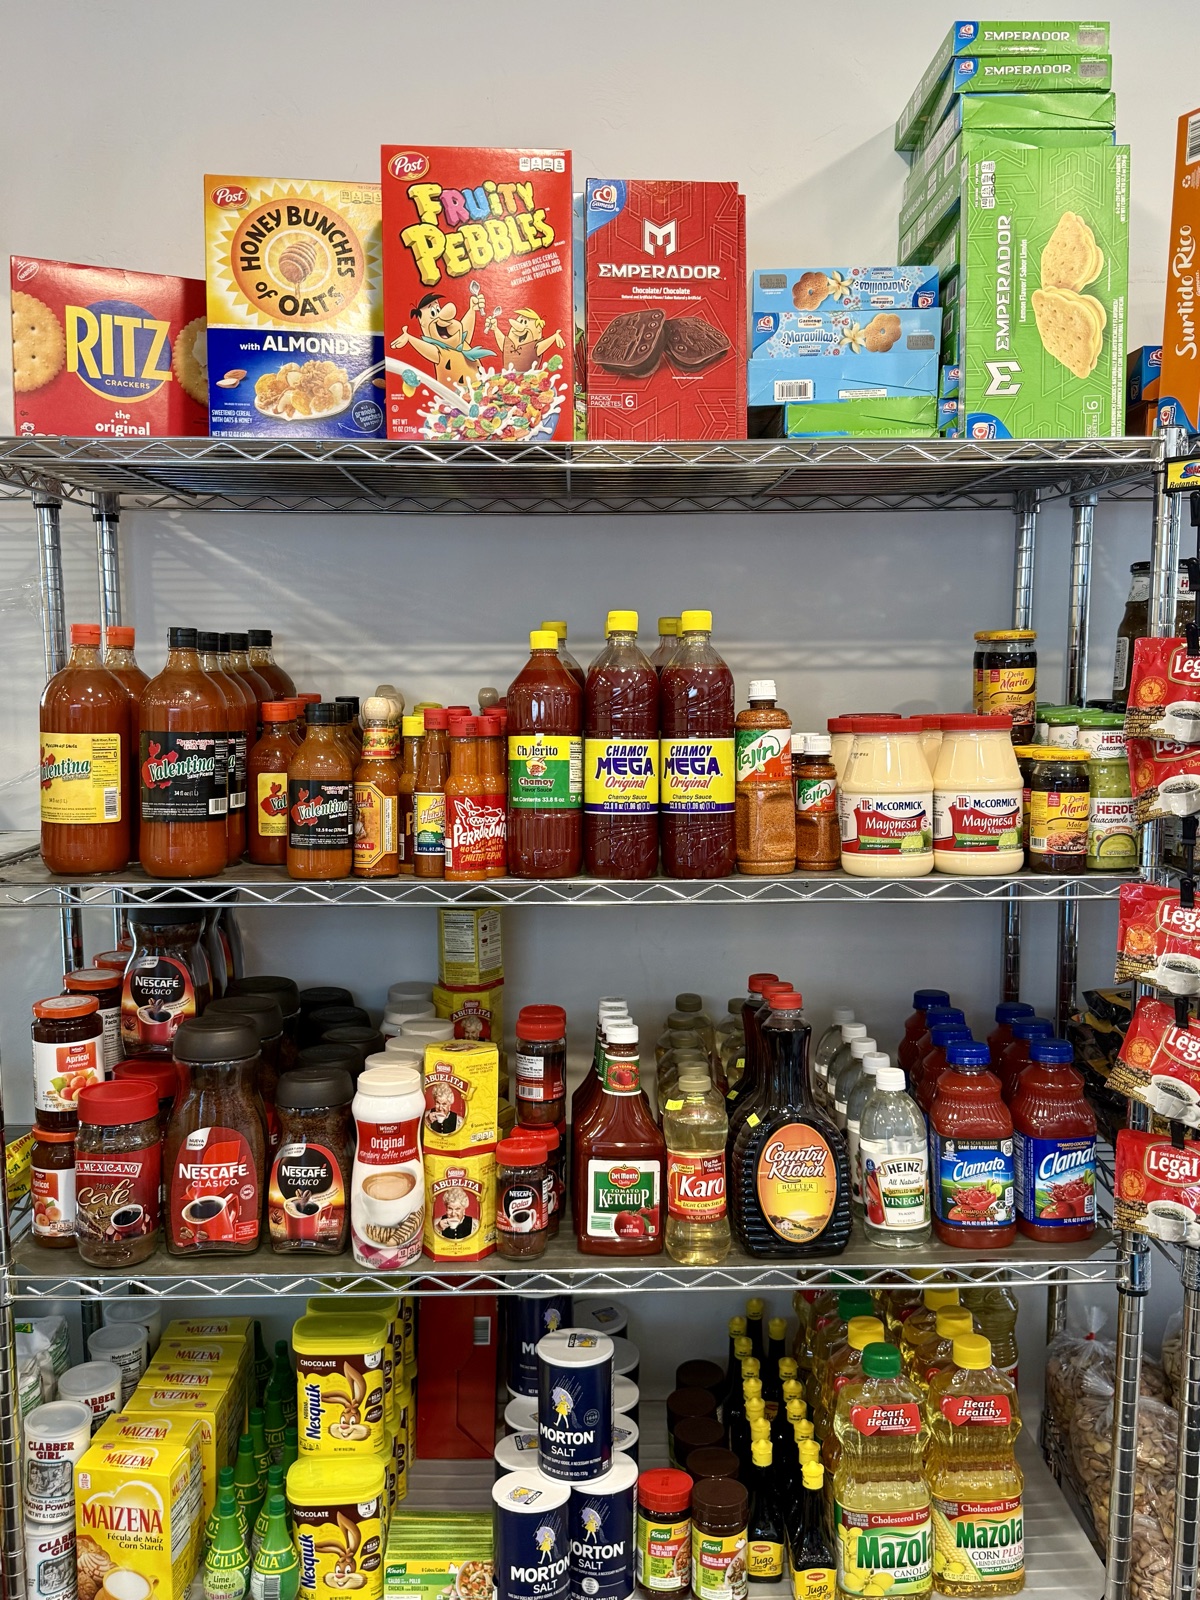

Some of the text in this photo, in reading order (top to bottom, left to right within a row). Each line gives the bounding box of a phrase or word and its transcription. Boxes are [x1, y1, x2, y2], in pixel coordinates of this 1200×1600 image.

[984, 31, 1070, 41] EMPERADOR
[984, 64, 1072, 76] EMPERADOR
[394, 157, 423, 176] Post
[215, 187, 245, 204] Post
[241, 205, 356, 279] HONEY BUNCHES
[400, 209, 555, 286] PEBBLES
[1019, 239, 1028, 258] Limón
[507, 252, 559, 274] SWEETENED RICE CEREAL
[532, 259, 561, 274] NATURAL AND
[510, 266, 562, 286] ARTIFICIAL FRUIT FLAVOR
[598, 263, 722, 280] EMPERADOR
[996, 215, 1011, 351] EMPERADOR
[255, 281, 278, 300] of
[663, 287, 690, 295] Chocolate
[1172, 224, 1197, 359] Surtido Rico
[1019, 303, 1027, 323] Lemon
[65, 305, 173, 382] RITZ
[784, 330, 834, 346] Maravillas
[240, 336, 361, 356] with ALMONDS
[105, 379, 151, 390] CRACKERS
[625, 395, 634, 407] 6
[1087, 400, 1099, 411] 6
[115, 410, 131, 421] the
[355, 408, 376, 419] granola
[95, 419, 150, 436] original
[1170, 480, 1198, 489] Botanas
[606, 745, 648, 757] CHAMOY
[670, 745, 712, 757] CHAMOY
[149, 754, 215, 782] Valentina
[595, 757, 655, 779] MEGA
[664, 757, 723, 779] MEGA
[519, 777, 555, 788] Chamoy
[605, 776, 648, 792] Original
[670, 776, 713, 792] Original
[875, 801, 923, 811] McCORMICK
[973, 798, 1017, 808] McCORMICK
[962, 814, 1013, 833] Mayonesa
[1090, 815, 1127, 824] Guacamole
[866, 817, 917, 835] Mayonesa
[135, 975, 181, 988] NESCAFÉ
[141, 987, 173, 996] CLÁSICO
[452, 1009, 491, 1019] ABUELITA
[66, 1054, 89, 1063] Apricot
[424, 1072, 464, 1089] ABUELITA
[371, 1135, 405, 1151] Original
[381, 1149, 399, 1159] coffee
[765, 1142, 828, 1165] Country
[84, 1163, 138, 1173] MEXICANO
[179, 1156, 249, 1179] NESCAFÉ
[282, 1165, 328, 1177] NESCAFÉ
[767, 1160, 825, 1182] Kitchen
[887, 1162, 920, 1174] HEINZ
[952, 1157, 1006, 1182] Clamato
[1150, 1150, 1199, 1180] Legal
[288, 1178, 321, 1186] CLÁSICO
[620, 1172, 638, 1180] Monte
[900, 1177, 920, 1185] Natural
[192, 1179, 239, 1188] CLÁSICO
[433, 1179, 479, 1192] ABUELITA
[680, 1175, 724, 1197] Karo
[78, 1178, 135, 1206] Café
[599, 1188, 649, 1208] KETCHUP
[884, 1195, 924, 1205] VINEGAR
[186, 1325, 228, 1333] MAIZENA
[176, 1350, 220, 1360] MAIZENA
[300, 1359, 336, 1367] CHOCOLATE
[164, 1374, 209, 1384] MAIZENA
[153, 1391, 200, 1399] MAIZENA
[963, 1400, 994, 1408] Heart
[305, 1383, 325, 1440] Nesquik
[873, 1409, 904, 1418] Heart
[957, 1408, 1001, 1416] Healthy
[867, 1417, 911, 1426] Healthy
[119, 1425, 167, 1439] MAIZENA
[539, 1422, 594, 1445] MORTON
[28, 1441, 74, 1451] CLABBER
[551, 1445, 576, 1457] SALT
[36, 1450, 62, 1460] GIRL
[103, 1453, 154, 1467] MAIZENA
[293, 1508, 329, 1517] CHOCOLATE
[961, 1501, 1019, 1512] Cholesterol Free
[81, 1503, 164, 1534] MAIZENA
[871, 1514, 914, 1523] Cholesterol
[915, 1511, 929, 1519] Free
[107, 1532, 164, 1544] Fécula de Maíz
[651, 1531, 670, 1539] Knorr
[956, 1518, 1022, 1548] Mazola
[118, 1541, 164, 1551] Corn Starch
[703, 1541, 721, 1551] Knorr
[207, 1549, 244, 1568] SICILIA
[972, 1547, 1023, 1561] CORN PLUS
[298, 1534, 319, 1589] Nesquik
[578, 1559, 604, 1570] SALT
[752, 1556, 774, 1568] Jugo
[511, 1555, 571, 1582] MORTON
[894, 1566, 927, 1578] CANOLA
[213, 1575, 229, 1583] Lime
[208, 1581, 235, 1590] Squeeze
[533, 1579, 557, 1594] SALT
[806, 1584, 829, 1597] Jugo
